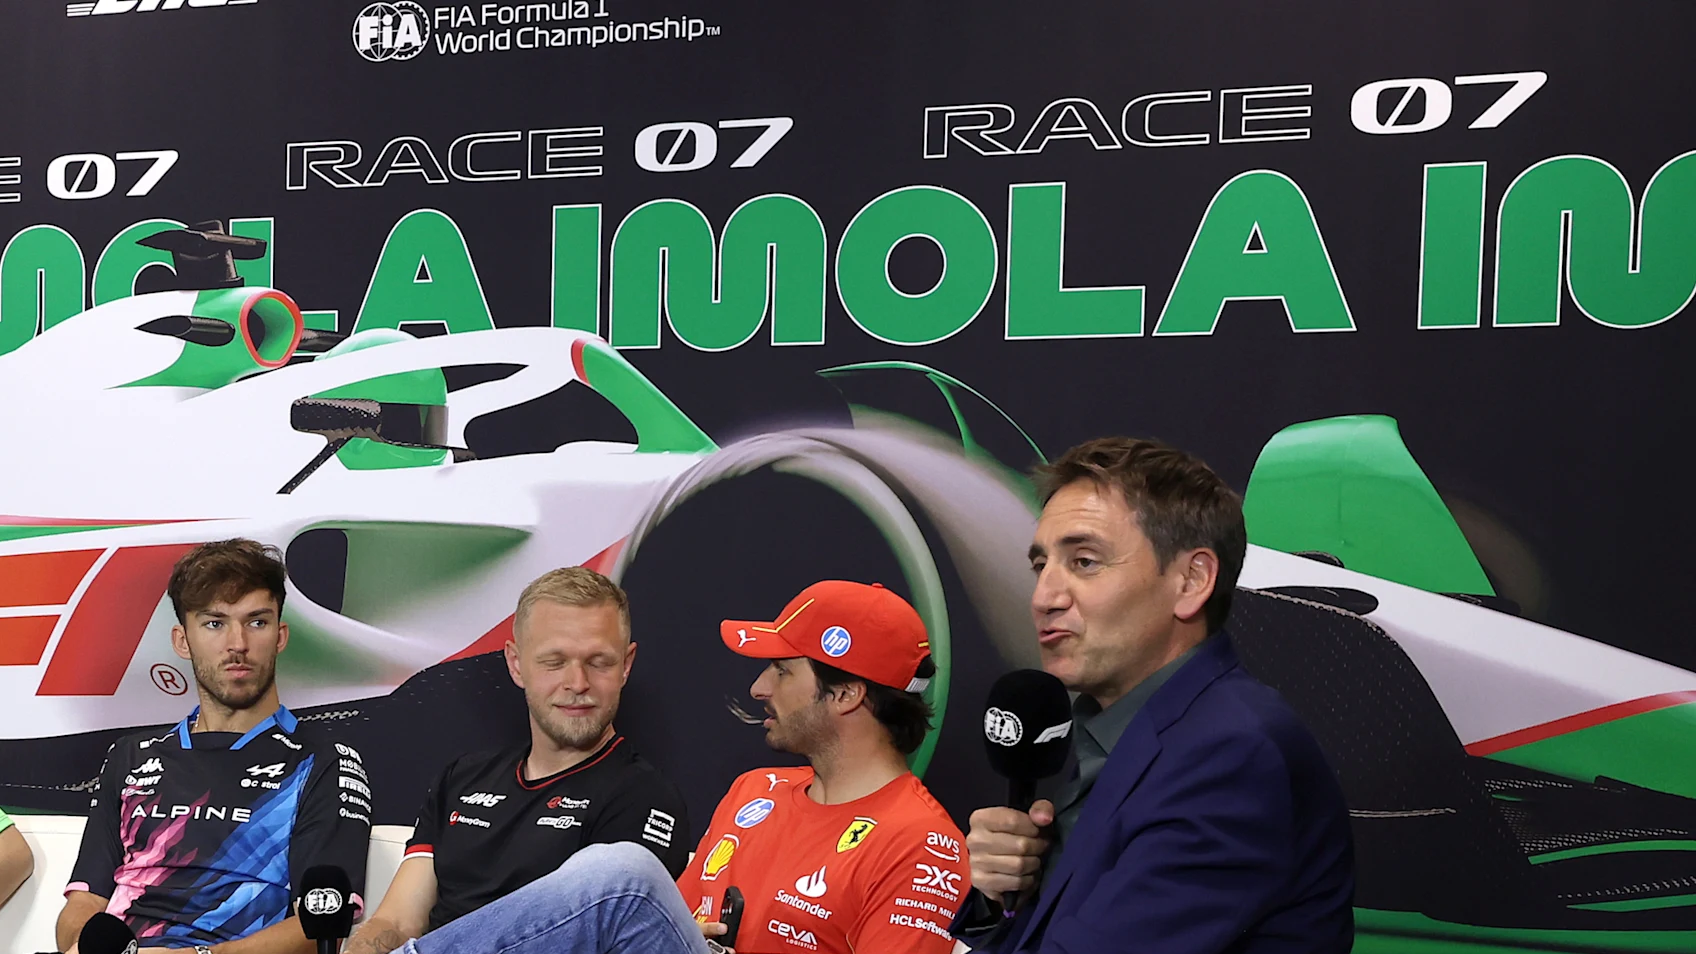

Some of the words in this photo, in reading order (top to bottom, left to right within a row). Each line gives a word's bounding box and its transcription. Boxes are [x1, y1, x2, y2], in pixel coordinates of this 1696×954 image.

[433, 7, 476, 29] FIA
[481, 0, 589, 26] Formula
[433, 29, 511, 55] World
[516, 16, 705, 49] Championship
[923, 84, 1313, 159] RACE
[286, 126, 604, 190] RACE
[551, 169, 1357, 351] IMOLA
[824, 627, 849, 656] hp
[131, 804, 252, 822] ALPINE
[738, 799, 771, 828] hp
[926, 831, 960, 854] aws
[912, 863, 962, 895] DXC
[912, 885, 958, 902] TECHNOLOGY
[775, 890, 833, 920] Santander
[895, 898, 937, 912] RICHARD
[786, 938, 818, 950] LOGISTICS
